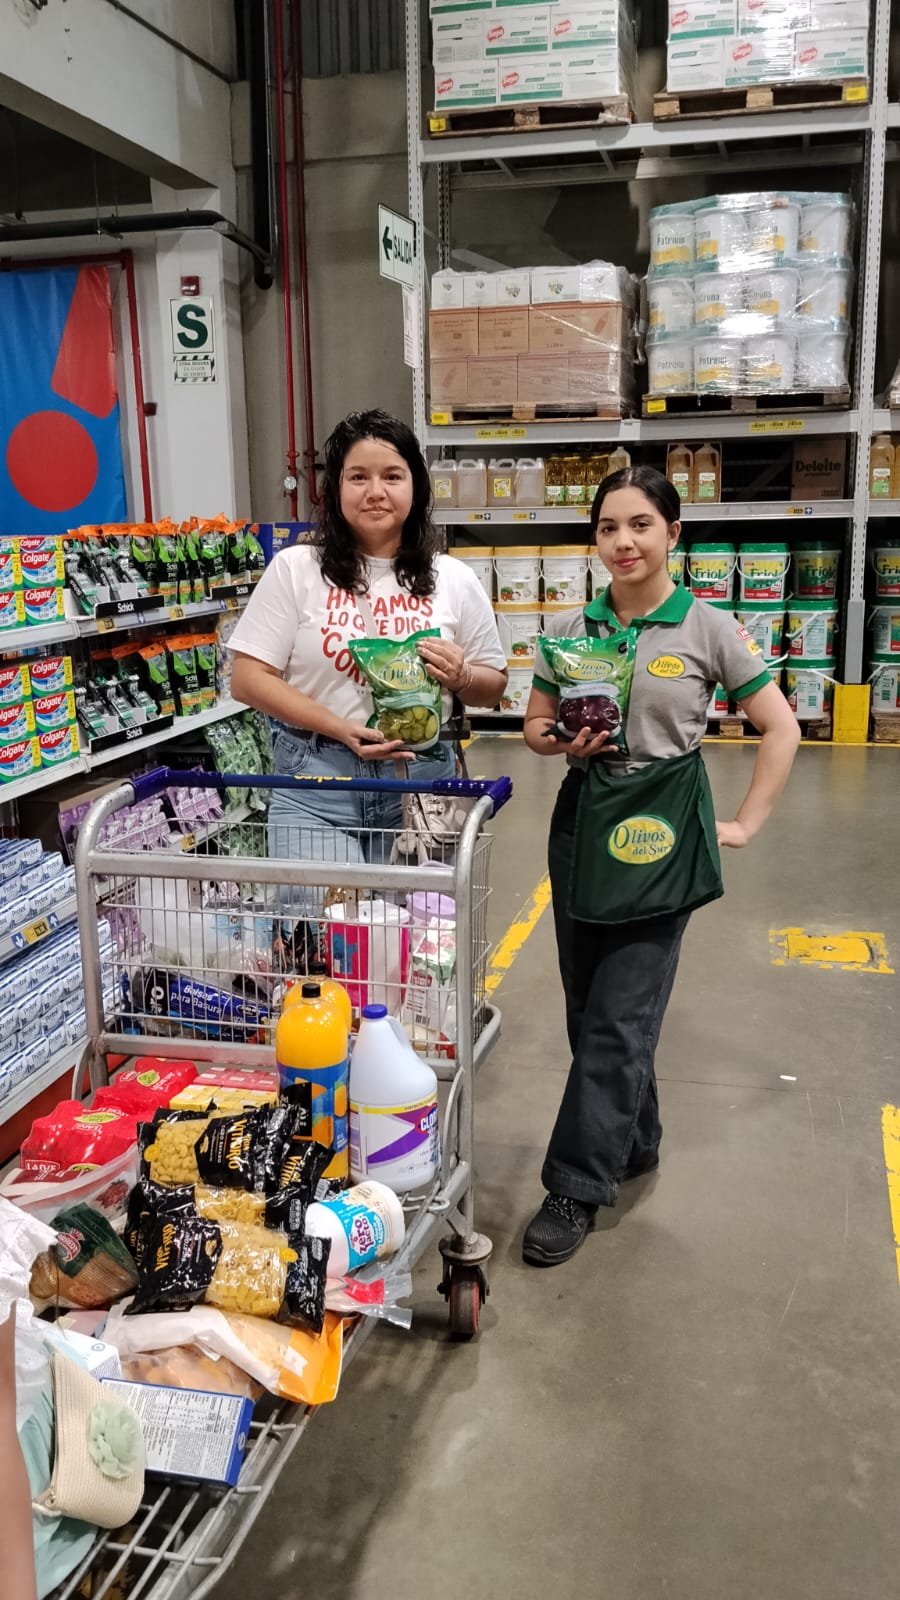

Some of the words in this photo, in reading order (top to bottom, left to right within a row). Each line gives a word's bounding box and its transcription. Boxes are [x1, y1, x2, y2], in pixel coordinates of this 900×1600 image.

[393, 236, 413, 266] SALIDA
[177, 304, 208, 348] S
[20, 539, 41, 548] Colgate
[22, 552, 50, 565] Colgate
[25, 589, 51, 602] Colgate
[117, 602, 135, 613] Schick
[328, 611, 349, 627] LO
[32, 661, 59, 675] Colgate
[36, 696, 62, 710] Colgate
[40, 730, 66, 745] Colgate
[126, 727, 143, 740] Schick
[614, 825, 666, 849] Olivos
[632, 845, 647, 856] del
[648, 844, 669, 856] Sur
[184, 984, 214, 1001] Bolsas
[170, 992, 191, 1004] para
[192, 997, 222, 1014] Basura
